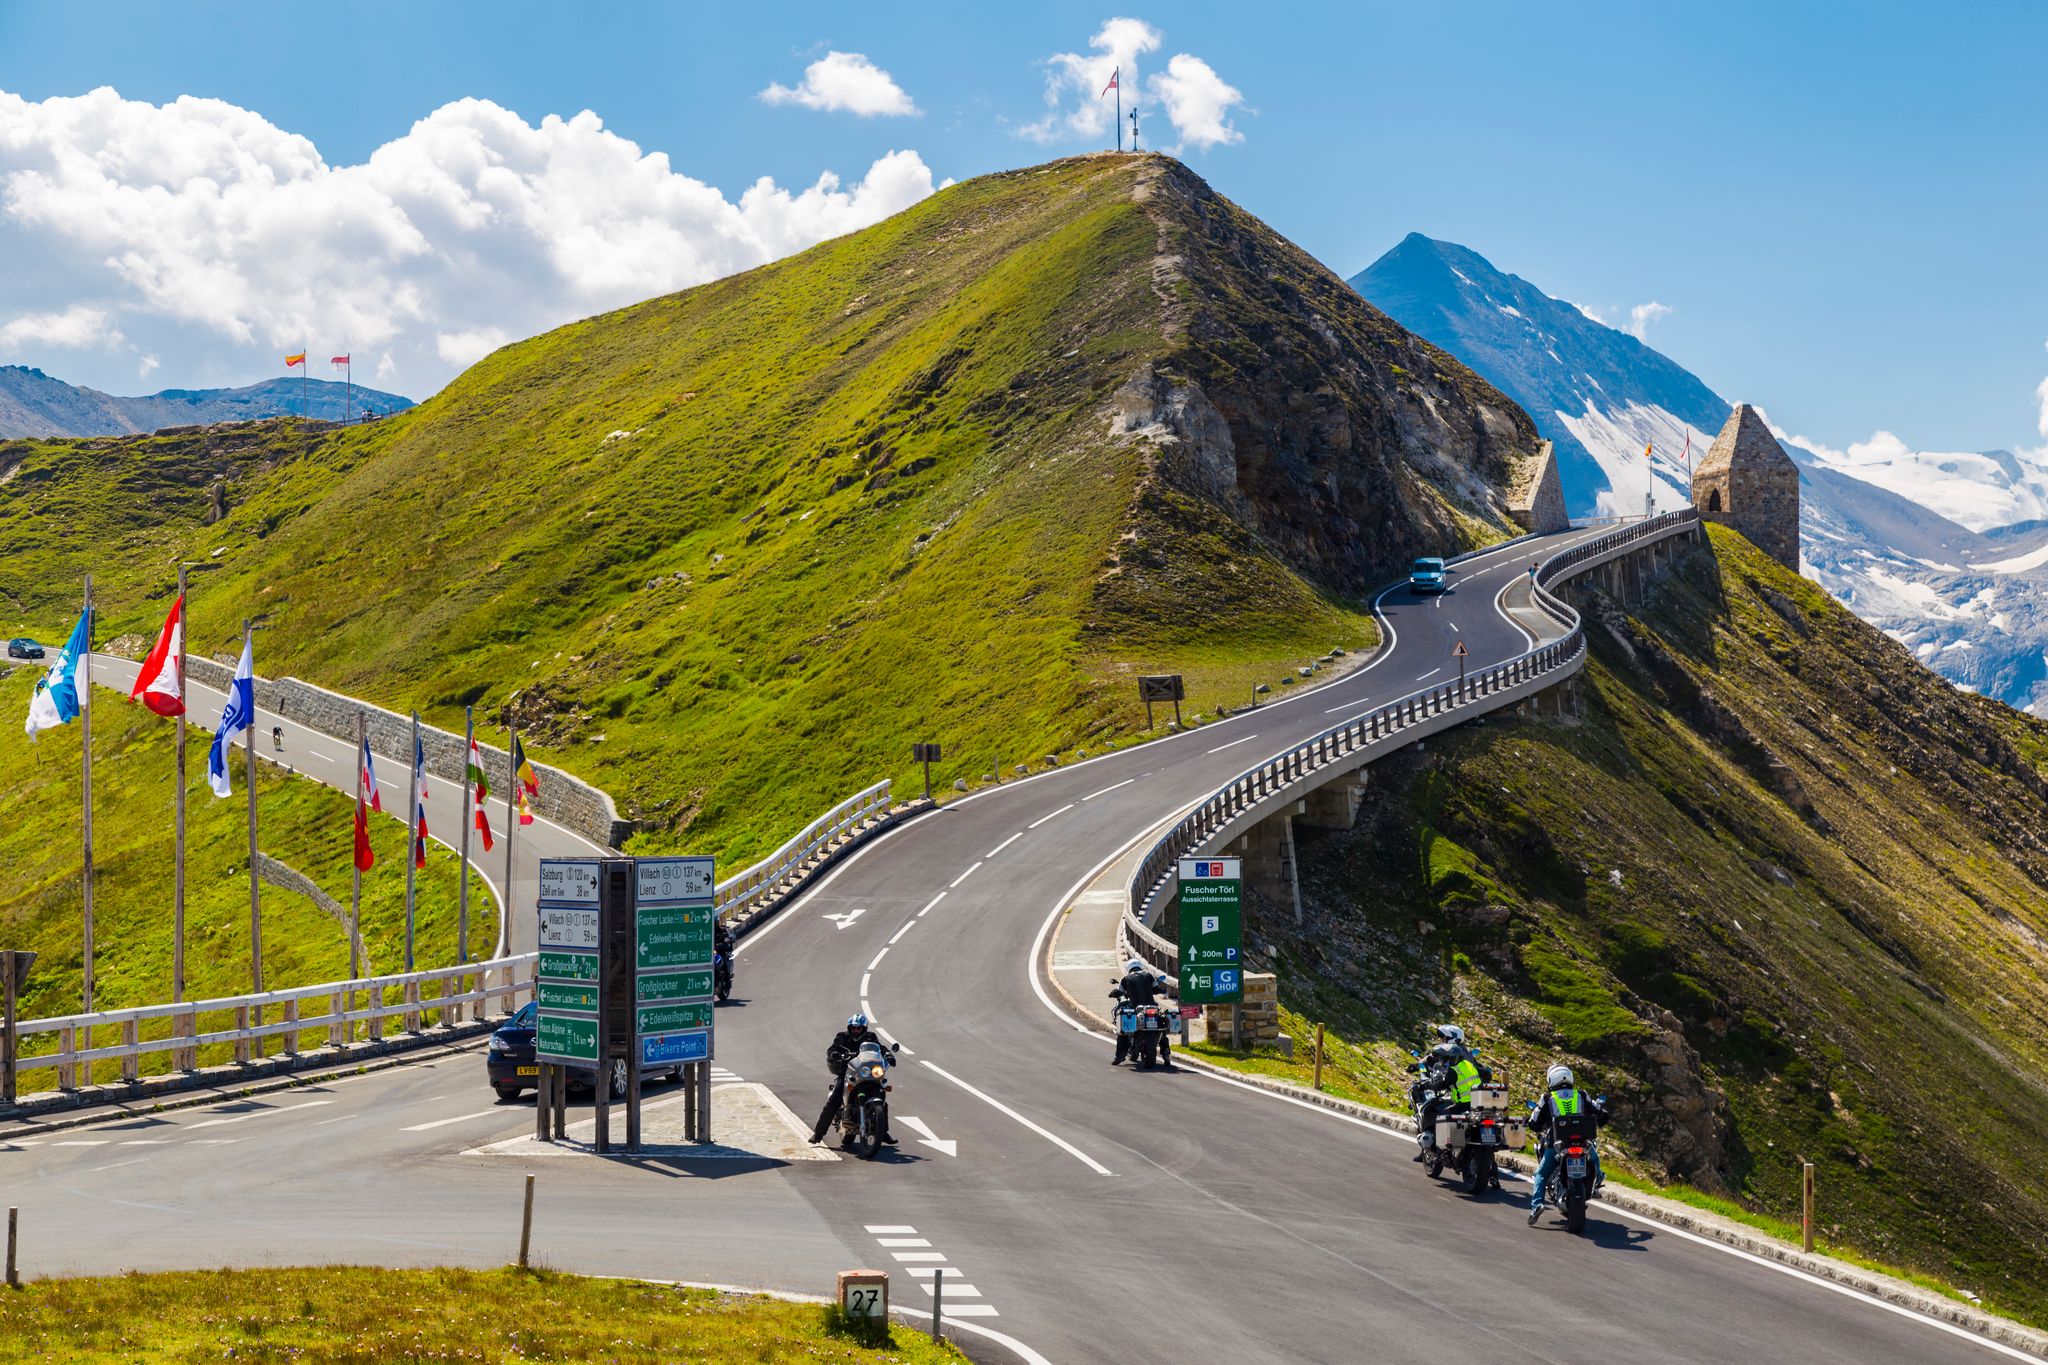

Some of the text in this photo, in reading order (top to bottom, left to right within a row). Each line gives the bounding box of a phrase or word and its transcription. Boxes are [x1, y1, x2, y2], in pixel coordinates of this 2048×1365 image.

[542, 868, 563, 884] Salzburg
[575, 869, 583, 880] 120
[584, 872, 590, 880] km
[640, 868, 660, 880] Villach
[684, 866, 694, 878] 137
[542, 884, 550, 896] Zell
[576, 885, 582, 897] 38
[640, 884, 656, 896] Lienz
[686, 882, 693, 894] 59
[1185, 886, 1235, 894] Fuscher Törl
[549, 913, 564, 925] Villach
[591, 917, 597, 926] km
[639, 911, 702, 926] Fuscher Lacke 2 km
[1207, 920, 1214, 929] 5
[549, 929, 561, 941] Lienz
[584, 930, 590, 942] 59
[591, 933, 597, 941] km
[699, 929, 702, 941] 2
[704, 932, 711, 941] km
[668, 951, 687, 962] Fuscher
[1227, 948, 1236, 959] P
[548, 960, 579, 974] Großglockner
[585, 962, 591, 974] 21
[1221, 971, 1232, 982] G
[639, 980, 678, 994] Großglockner
[688, 978, 694, 989] 21
[1215, 983, 1237, 991] SHOP
[546, 992, 596, 1005] Fuscher Lacke 2 km
[650, 1010, 694, 1024] Edelweißspitze
[700, 1009, 703, 1020] 2
[539, 1022, 551, 1032] Haus
[552, 1023, 565, 1036] Alpine
[580, 1036, 586, 1045] km
[539, 1038, 564, 1051] Naturschau
[660, 1041, 697, 1055] Bikers Point
[852, 1289, 878, 1312] 27
